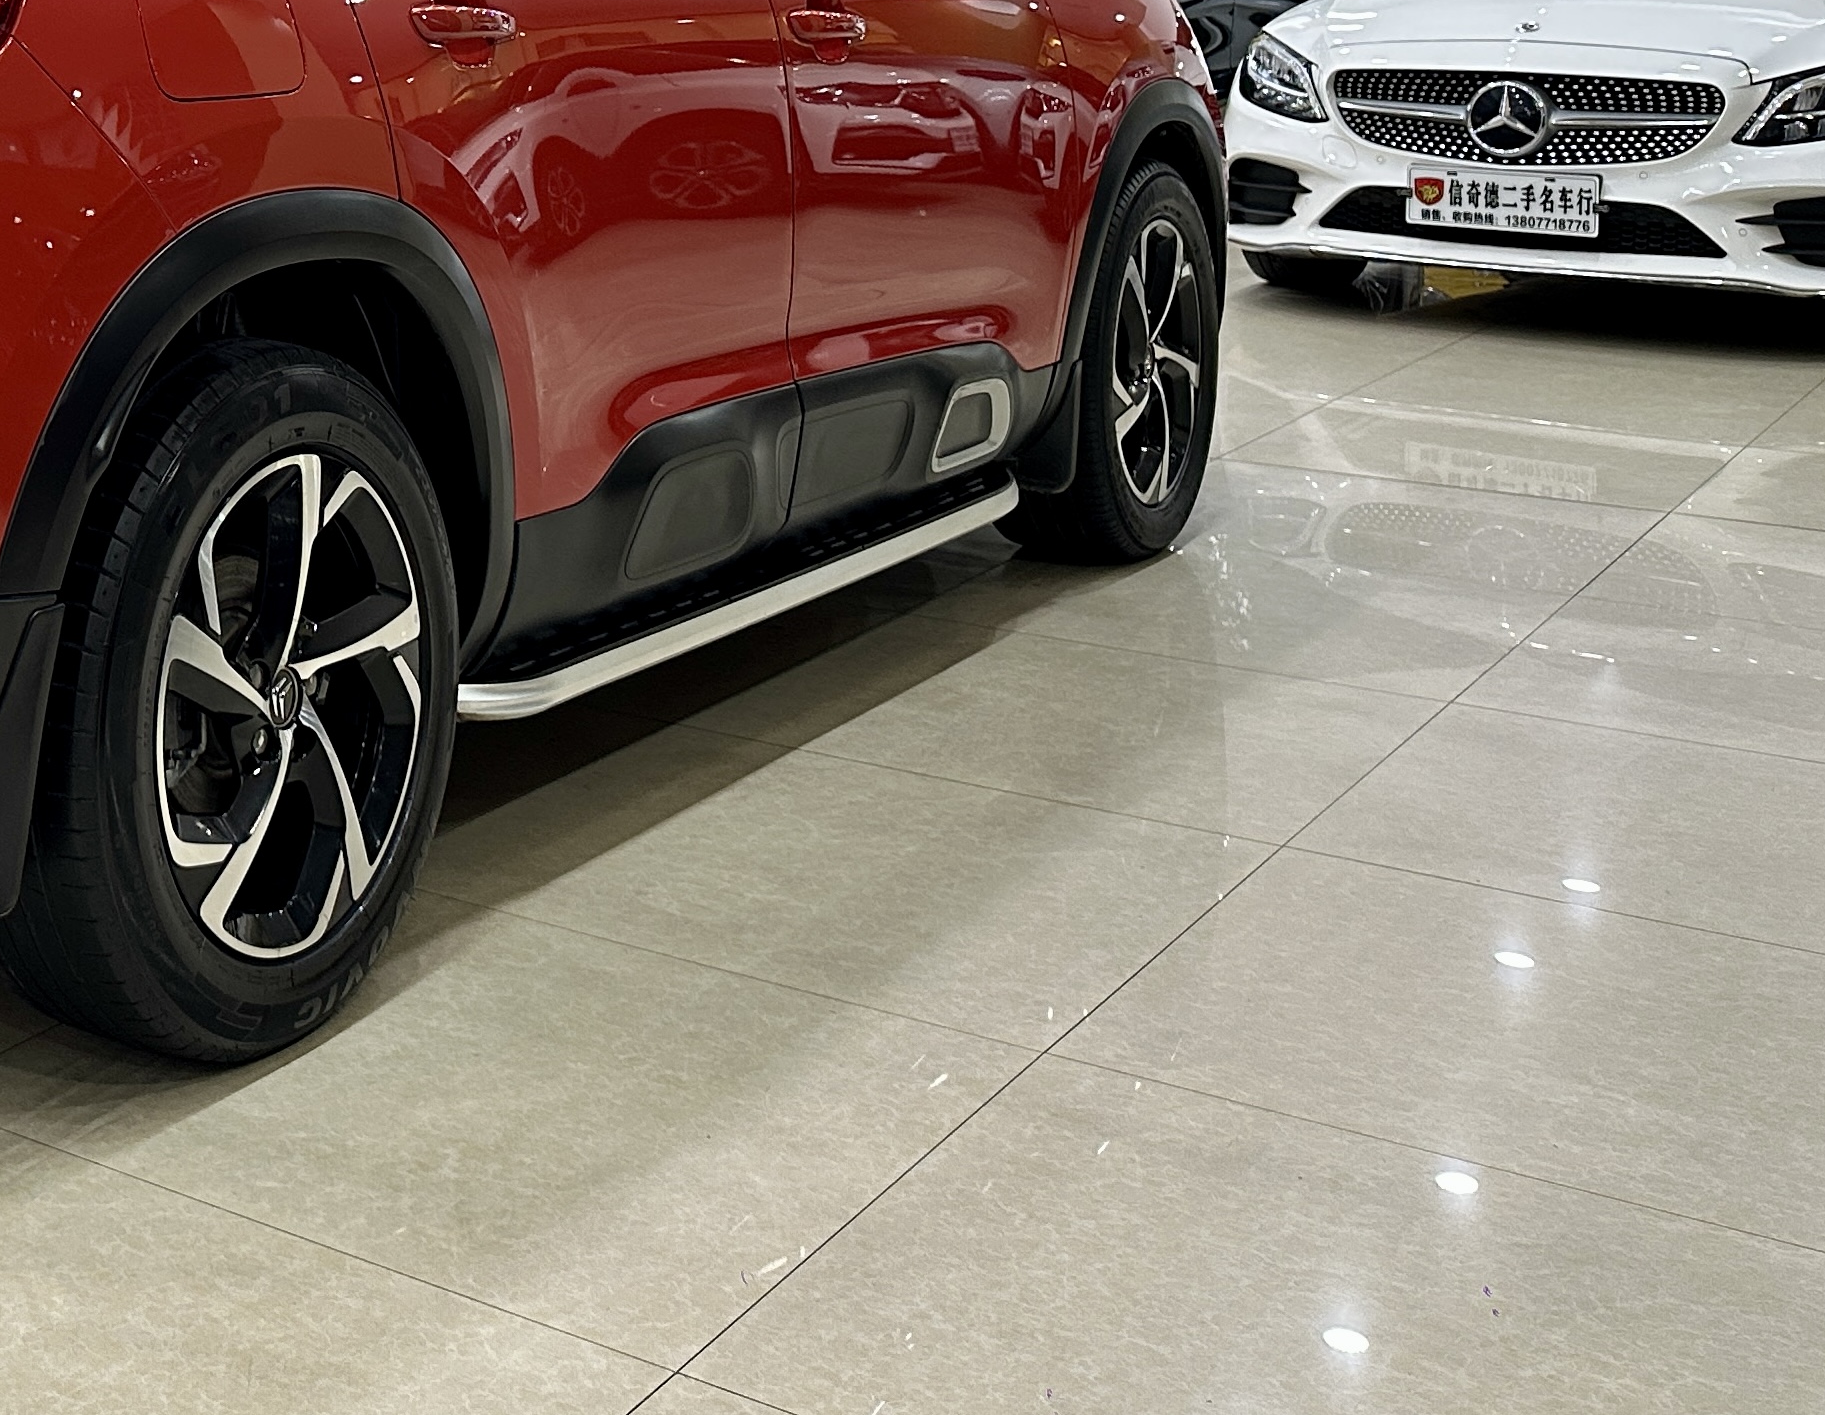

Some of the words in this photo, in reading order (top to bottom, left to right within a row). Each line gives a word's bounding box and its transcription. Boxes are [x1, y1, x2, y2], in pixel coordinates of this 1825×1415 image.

[1448, 179, 1593, 216] 信奇德二手名车行
[1505, 215, 1590, 233] 13807718776
